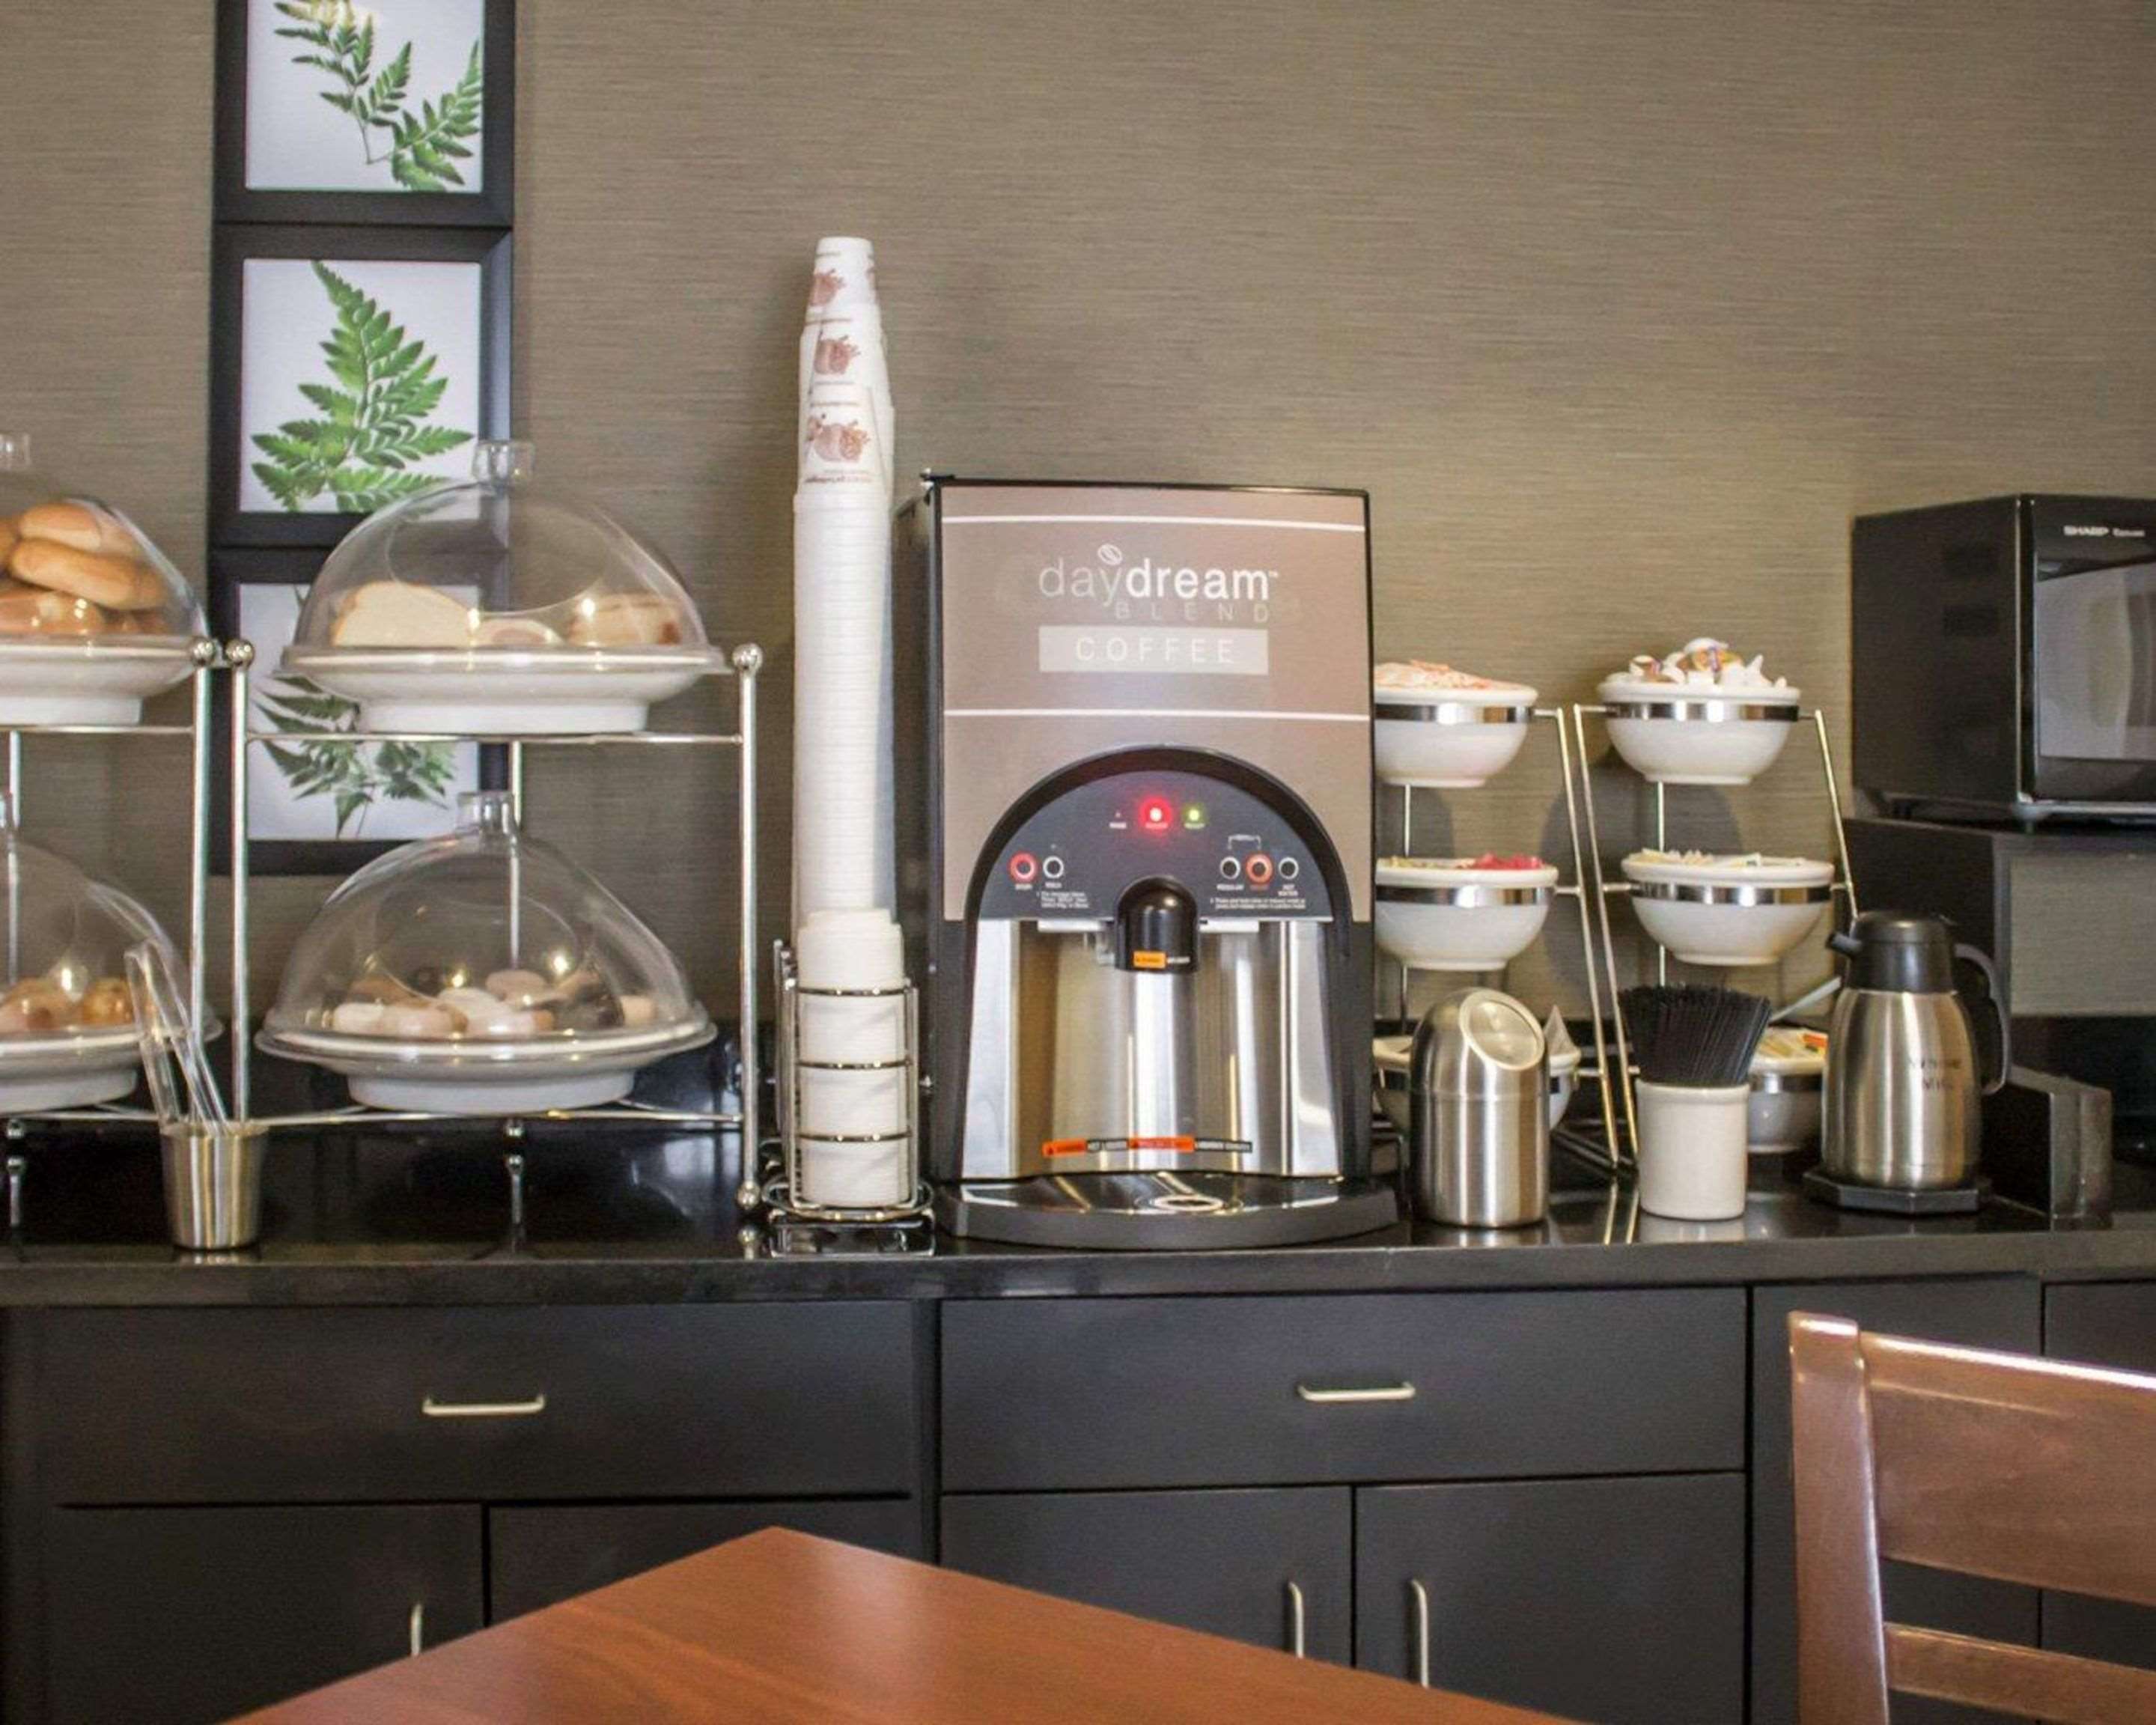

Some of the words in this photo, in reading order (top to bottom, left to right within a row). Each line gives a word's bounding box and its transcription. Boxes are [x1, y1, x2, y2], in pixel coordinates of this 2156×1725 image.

[2064, 525, 2110, 536] SHARP
[1115, 601, 1269, 623] BLEND
[1076, 636, 1234, 664] COFFEE
